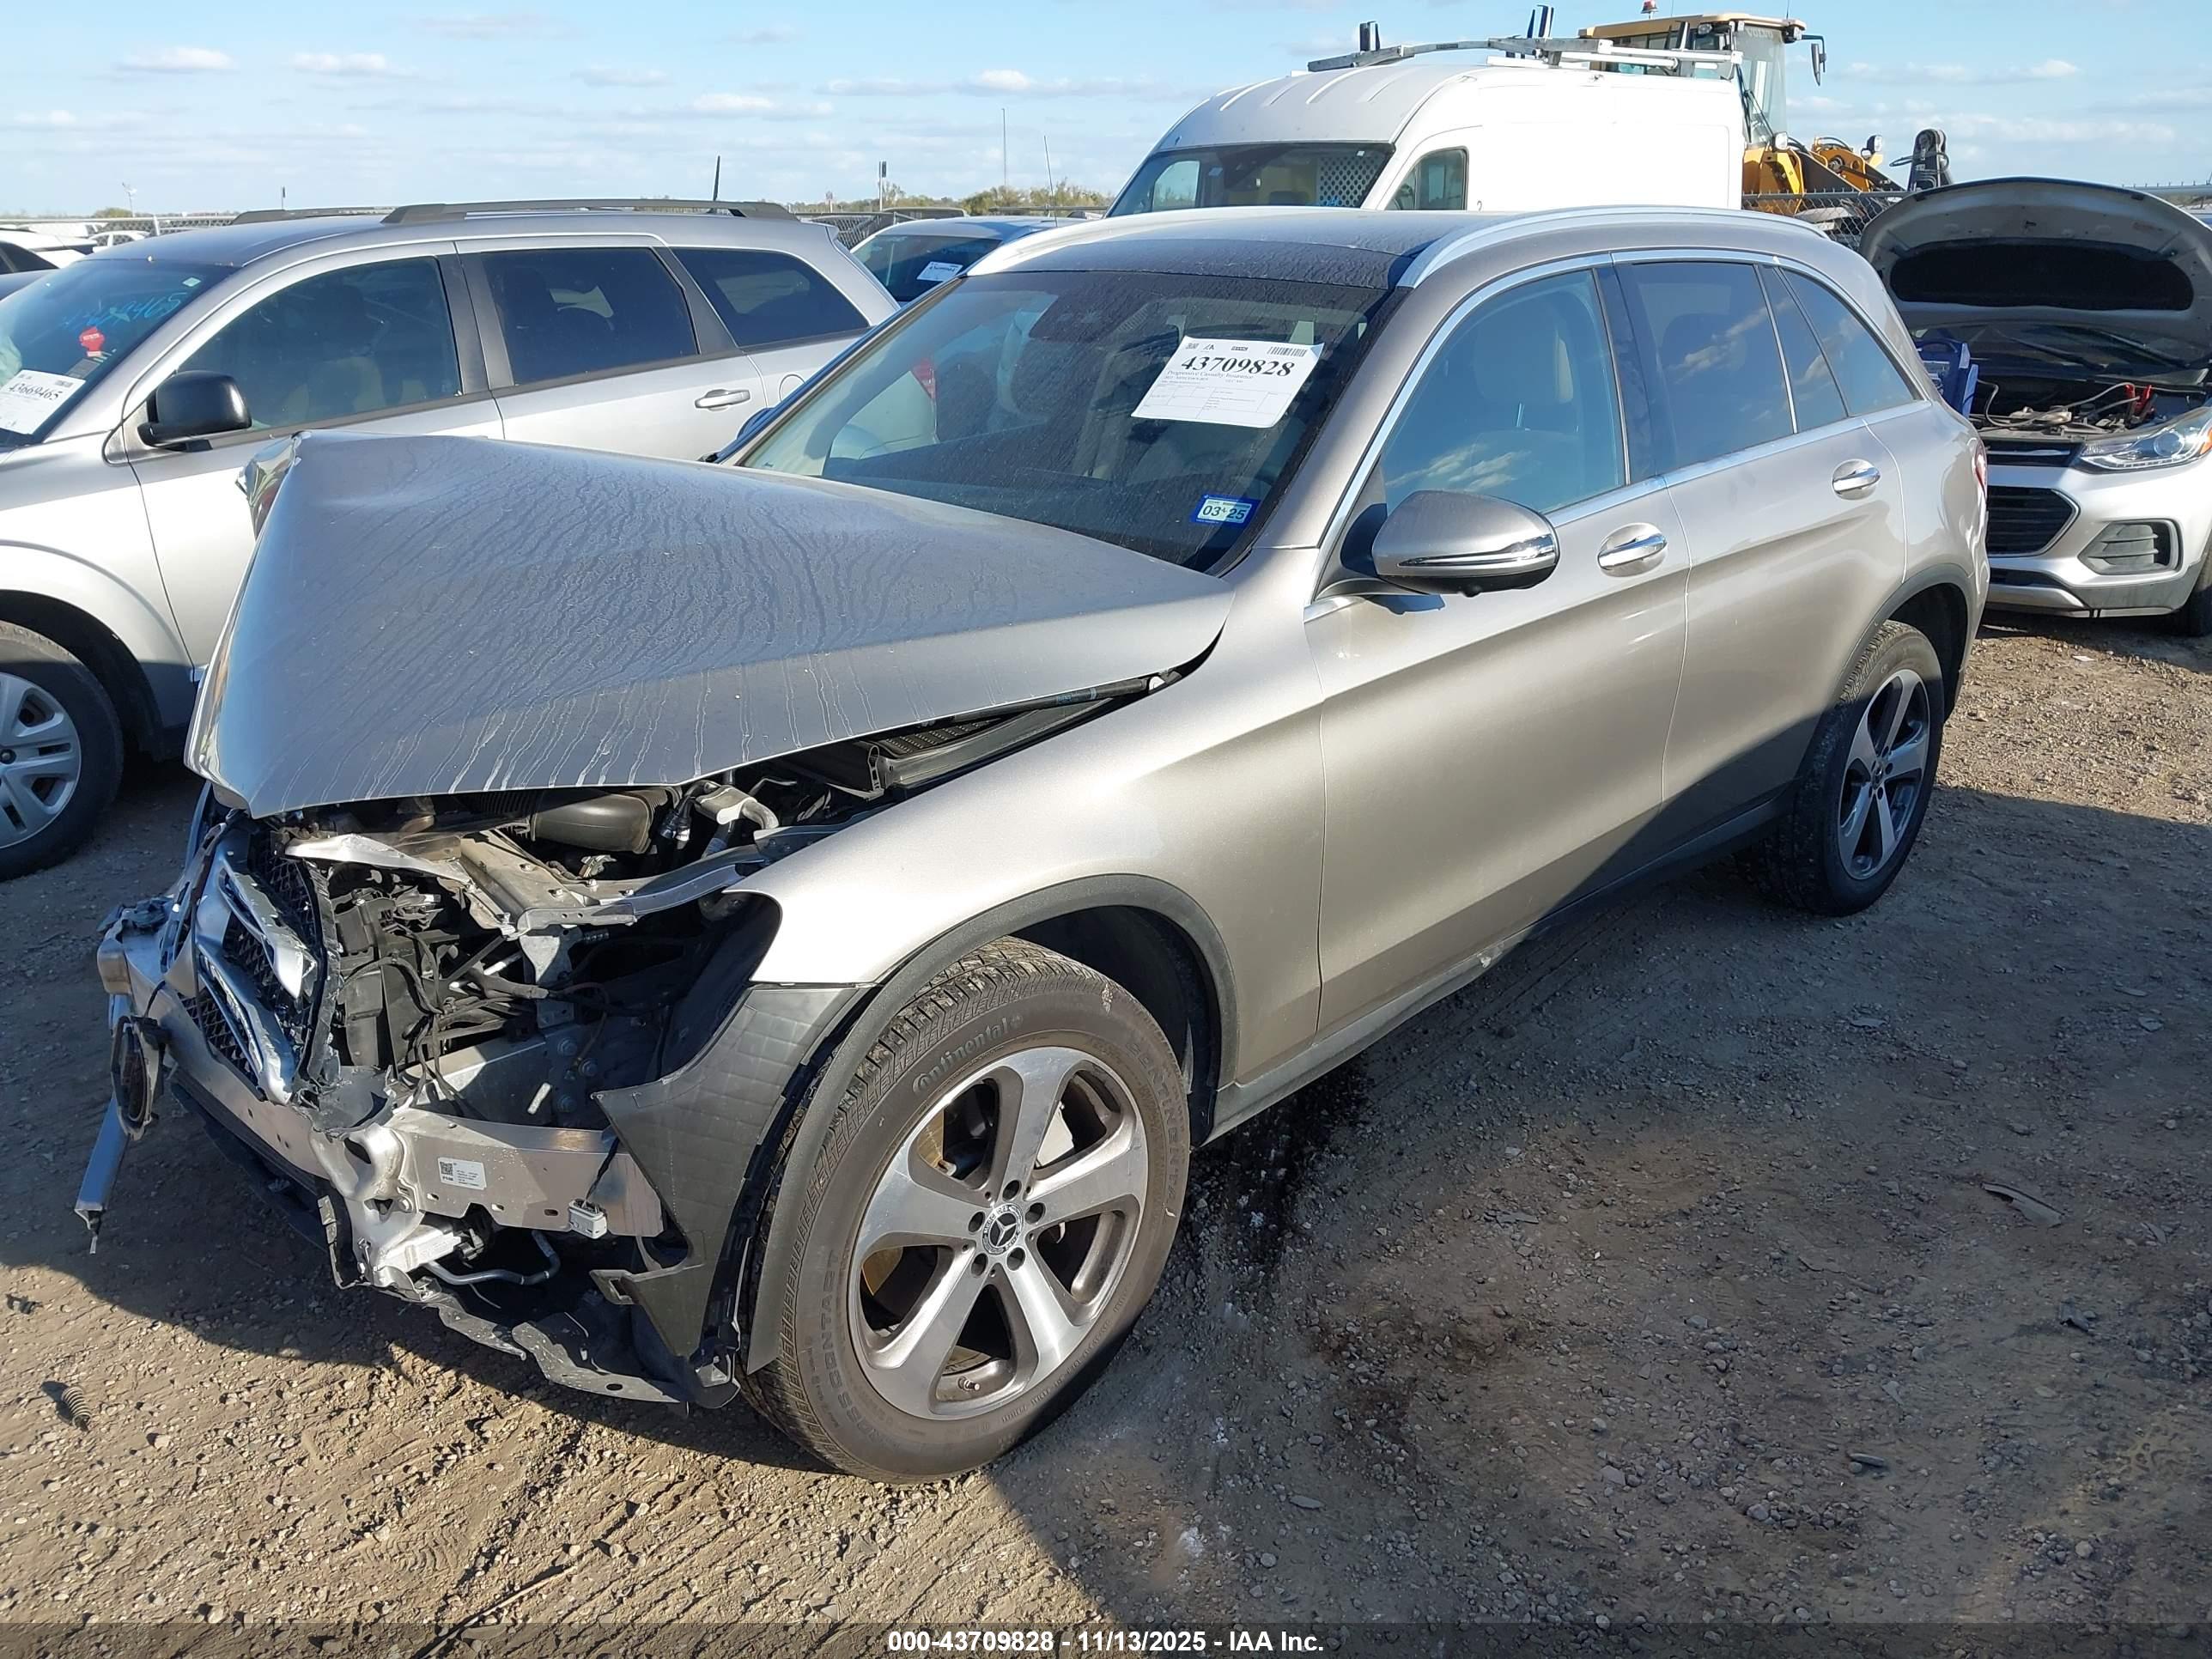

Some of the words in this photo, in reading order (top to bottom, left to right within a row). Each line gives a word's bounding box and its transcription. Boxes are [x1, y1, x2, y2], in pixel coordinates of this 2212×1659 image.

[1181, 356, 1296, 377] 43709828
[9, 382, 64, 400] 43669465
[1202, 505, 1221, 517] 03
[1226, 507, 1246, 520] 25
[912, 1017, 1009, 1097] Continental
